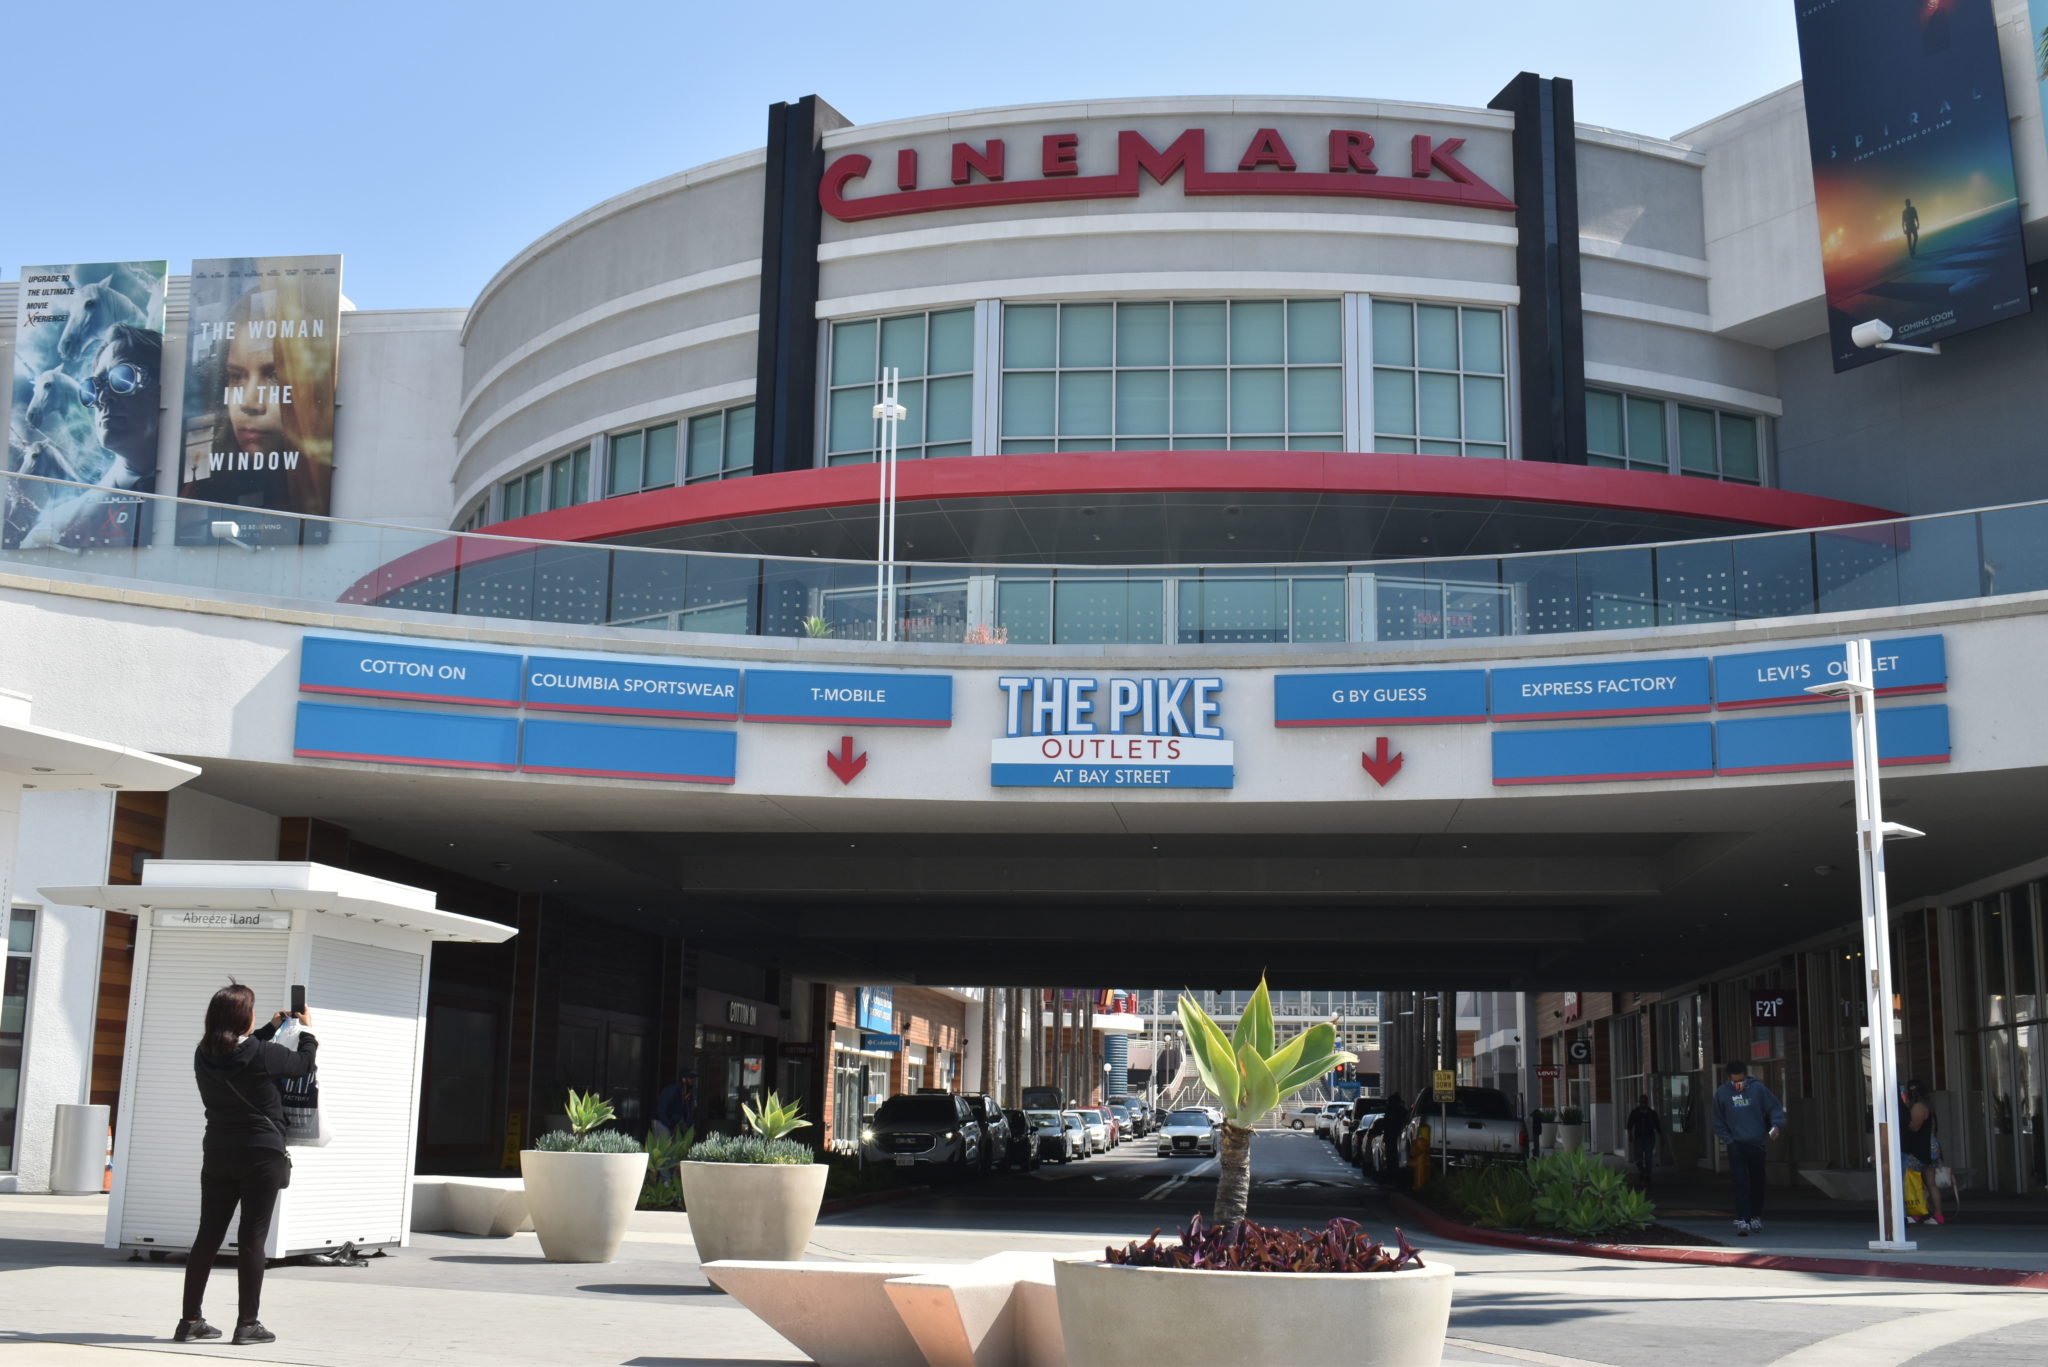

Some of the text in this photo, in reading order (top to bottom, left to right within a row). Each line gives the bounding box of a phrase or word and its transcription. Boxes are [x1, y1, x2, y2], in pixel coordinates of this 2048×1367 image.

[818, 127, 1521, 222] CINEMARK
[28, 274, 71, 284] UPGRADE TO
[27, 287, 75, 297] THE ULTIMATE
[26, 301, 49, 310] MOVIE
[200, 319, 325, 341] THE WOMAN
[1898, 317, 1930, 334] COMING
[1930, 309, 1954, 324] SOON
[223, 385, 293, 405] IN THE
[208, 451, 300, 472] WINDOW
[360, 658, 467, 681] COTTON ON
[1757, 663, 1811, 683] LEVI'S
[531, 673, 735, 698] COLUMBIA SPORTSWEAR
[811, 687, 886, 704] T-MOBILE
[1521, 677, 1677, 698] EXPRESS FACTORY
[1332, 688, 1427, 704] G BY GUESS
[998, 676, 1224, 741] THE PIKE
[1041, 737, 1181, 760] OUTLETS
[1053, 769, 1171, 784] AT BAY STREET
[183, 911, 261, 925] Abreeze iLand
[729, 1000, 749, 1025] COTTON
[1571, 1042, 1588, 1059] G
